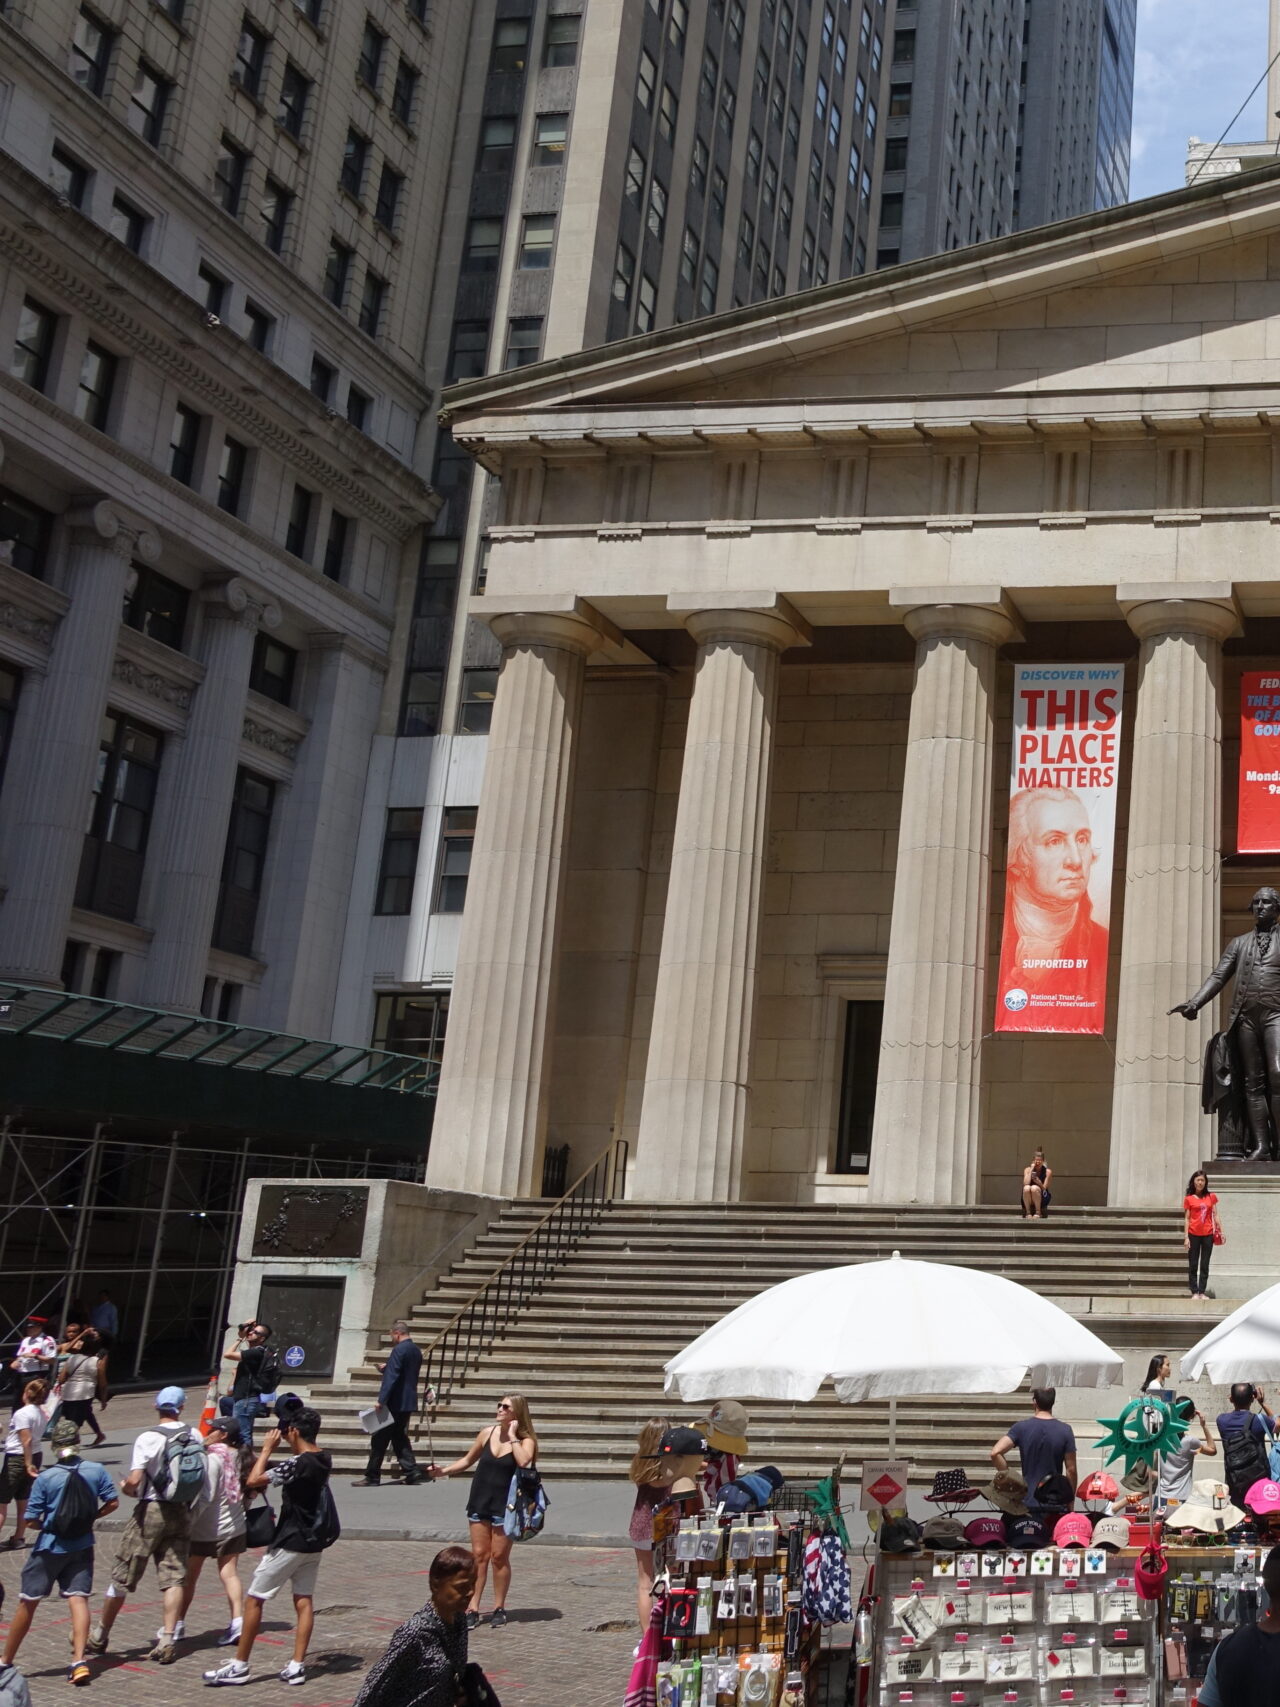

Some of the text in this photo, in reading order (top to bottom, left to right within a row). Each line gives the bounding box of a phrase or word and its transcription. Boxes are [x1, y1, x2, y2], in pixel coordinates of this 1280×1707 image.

[1020, 670, 1119, 680] DISCOVER WHY
[1247, 696, 1270, 707] THE
[1020, 688, 1117, 731] THIS
[1254, 710, 1270, 721] OF
[1020, 734, 1115, 764] PLACE
[1018, 766, 1114, 788] MATTERS
[1022, 959, 1088, 968] SUPPORTED BY
[982, 1523, 1000, 1532] NYC
[1015, 1520, 1042, 1530] NEW YORK
